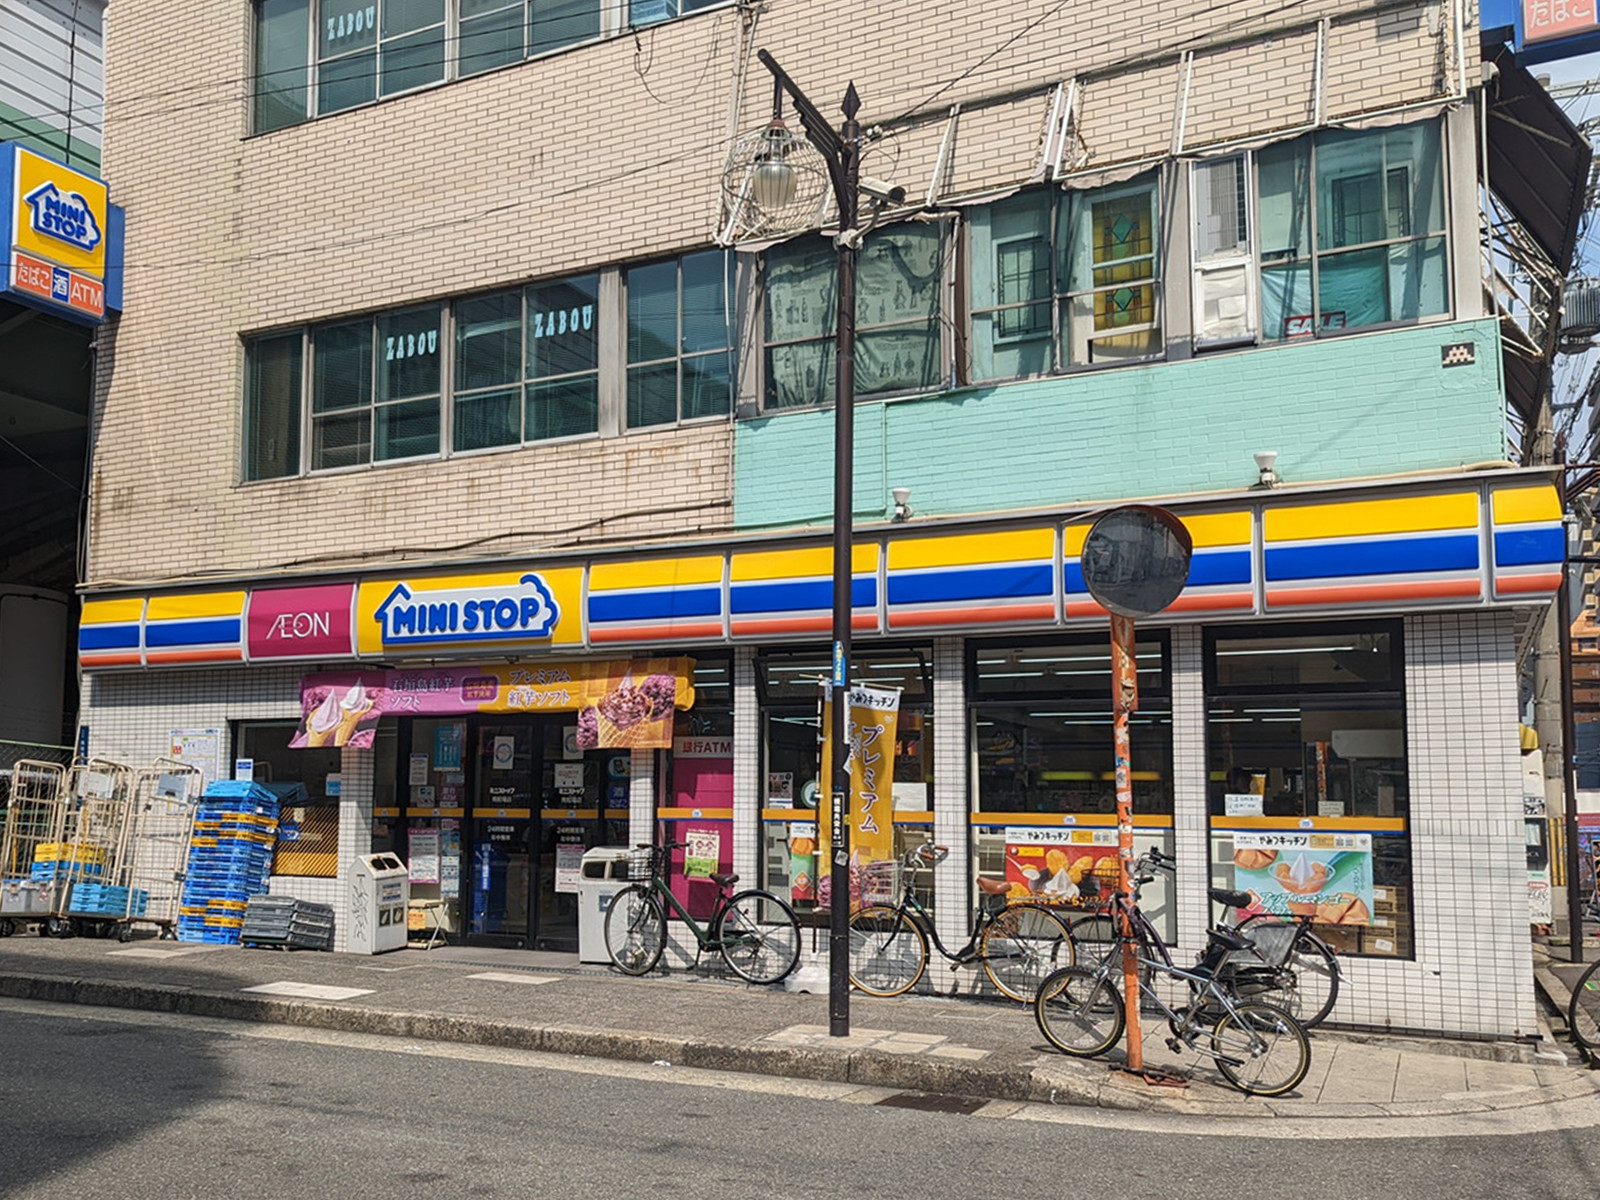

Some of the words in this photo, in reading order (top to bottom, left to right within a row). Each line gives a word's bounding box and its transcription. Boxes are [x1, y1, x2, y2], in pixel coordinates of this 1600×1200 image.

[327, 5, 376, 41] ZABOU
[42, 211, 88, 241] STOP
[45, 196, 85, 226] MINI
[17, 263, 51, 291] たばこ
[53, 273, 68, 297] 酒
[71, 281, 103, 309] ATM
[534, 304, 593, 339] ZABOU
[385, 329, 438, 361] ZABOU
[393, 605, 458, 636] MINI
[462, 597, 540, 632] STOP
[392, 676, 454, 693] 石垣島紅芋
[510, 669, 571, 685] プレミアム
[391, 696, 421, 711] ソフト
[508, 690, 571, 707] 紅芋ソフト
[682, 741, 732, 754] 銀行ATM
[860, 724, 885, 835] プレミアム
[1027, 831, 1070, 842] やみつキッチン
[1259, 835, 1308, 846] やみつキッチン
